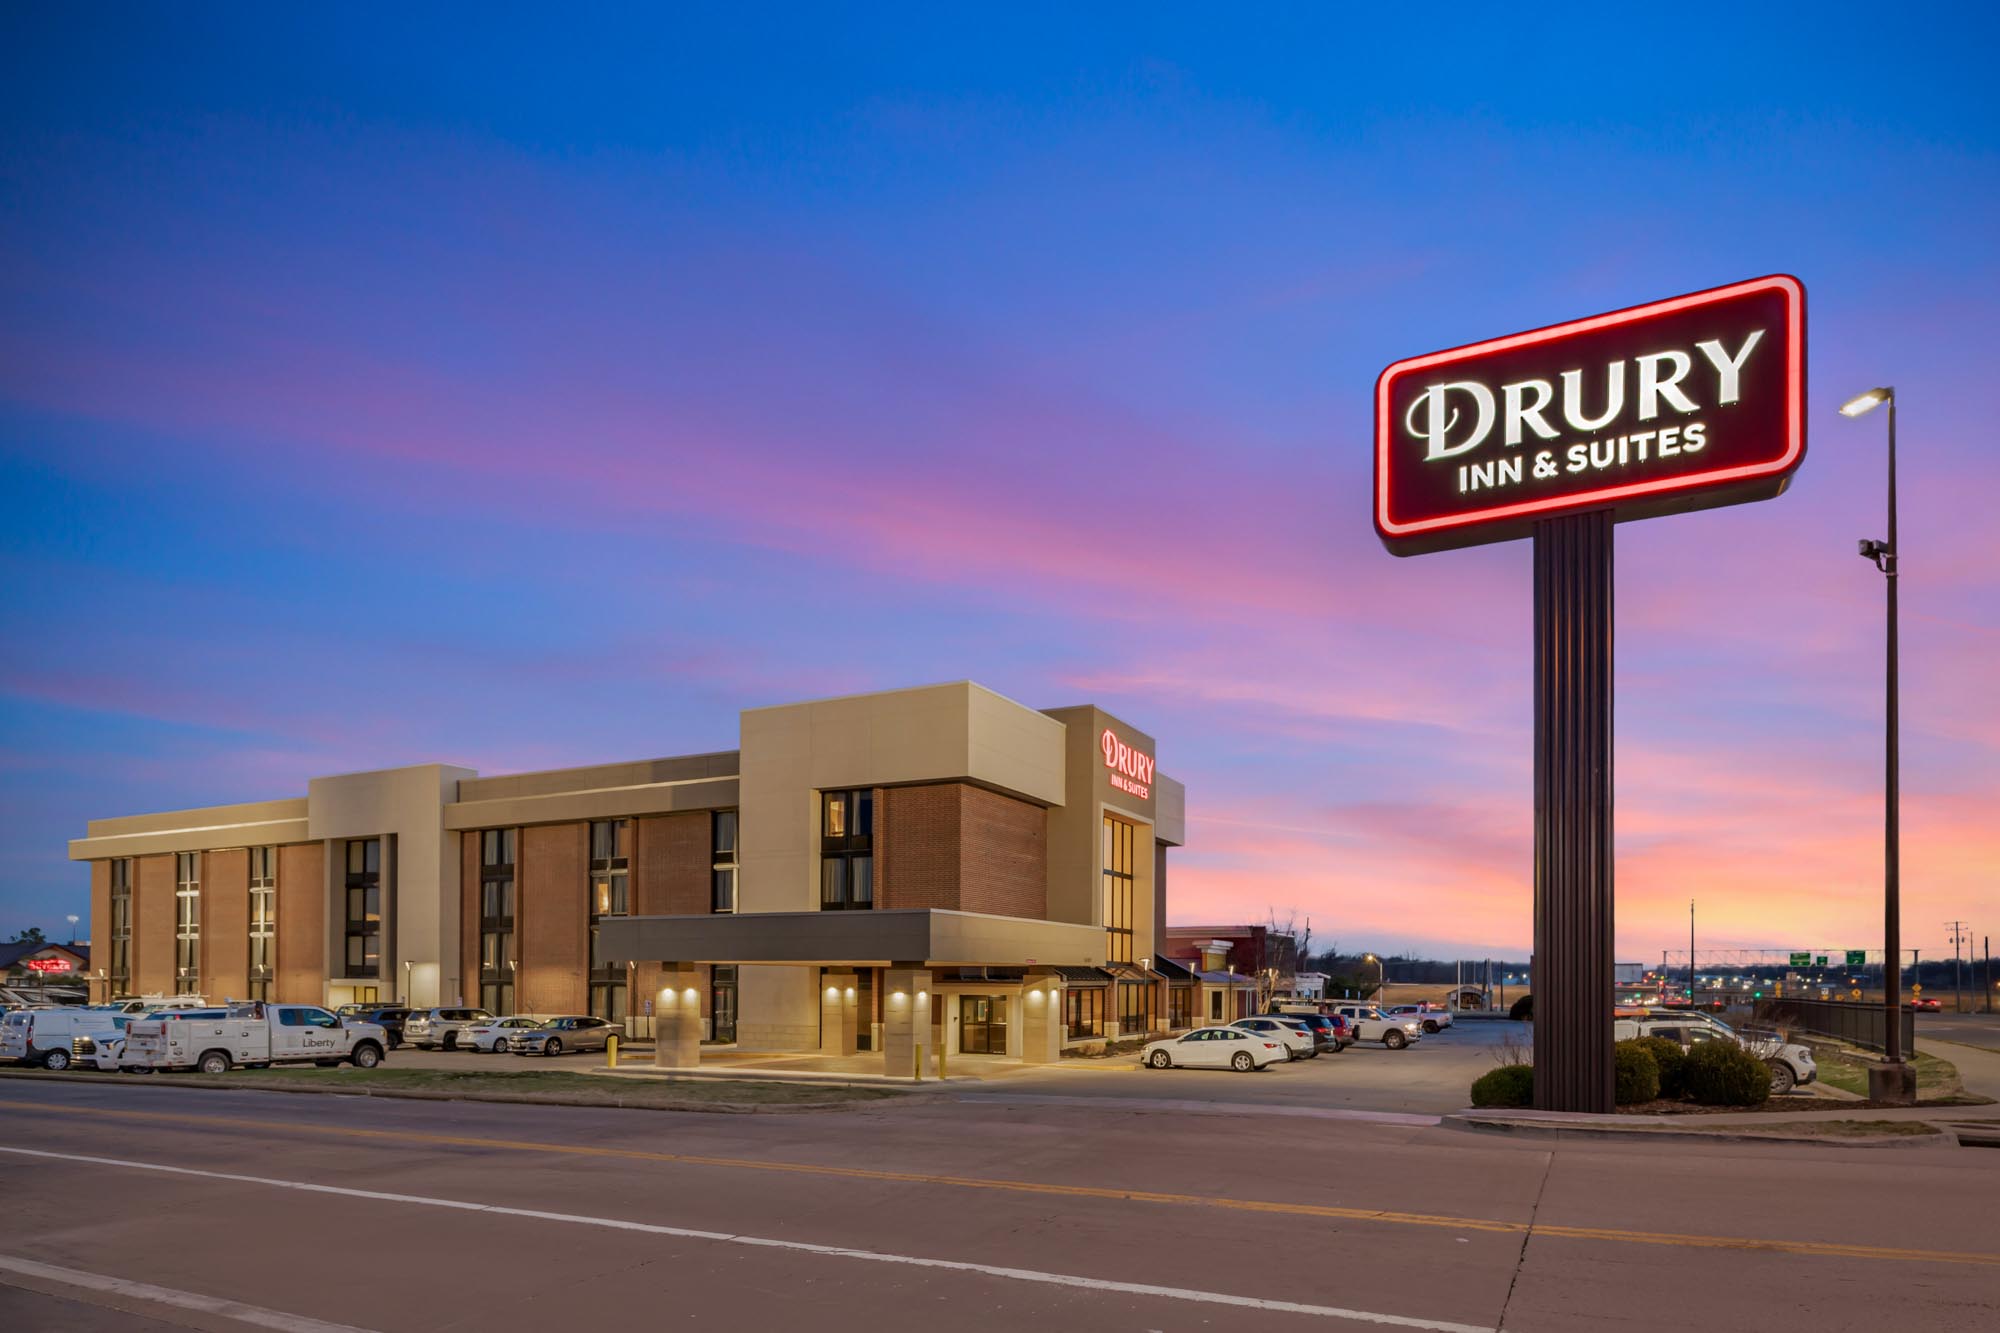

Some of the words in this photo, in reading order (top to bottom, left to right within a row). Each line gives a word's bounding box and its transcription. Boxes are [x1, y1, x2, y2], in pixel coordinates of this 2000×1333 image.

[1406, 329, 1766, 461] DRURY
[1459, 455, 1523, 492] INN
[1532, 451, 1559, 479] &
[1565, 422, 1707, 472] SUITES
[1102, 729, 1154, 785] DRURY
[1111, 773, 1123, 789] INN
[1128, 780, 1148, 800] SUITES
[303, 1038, 336, 1049] Liberty
